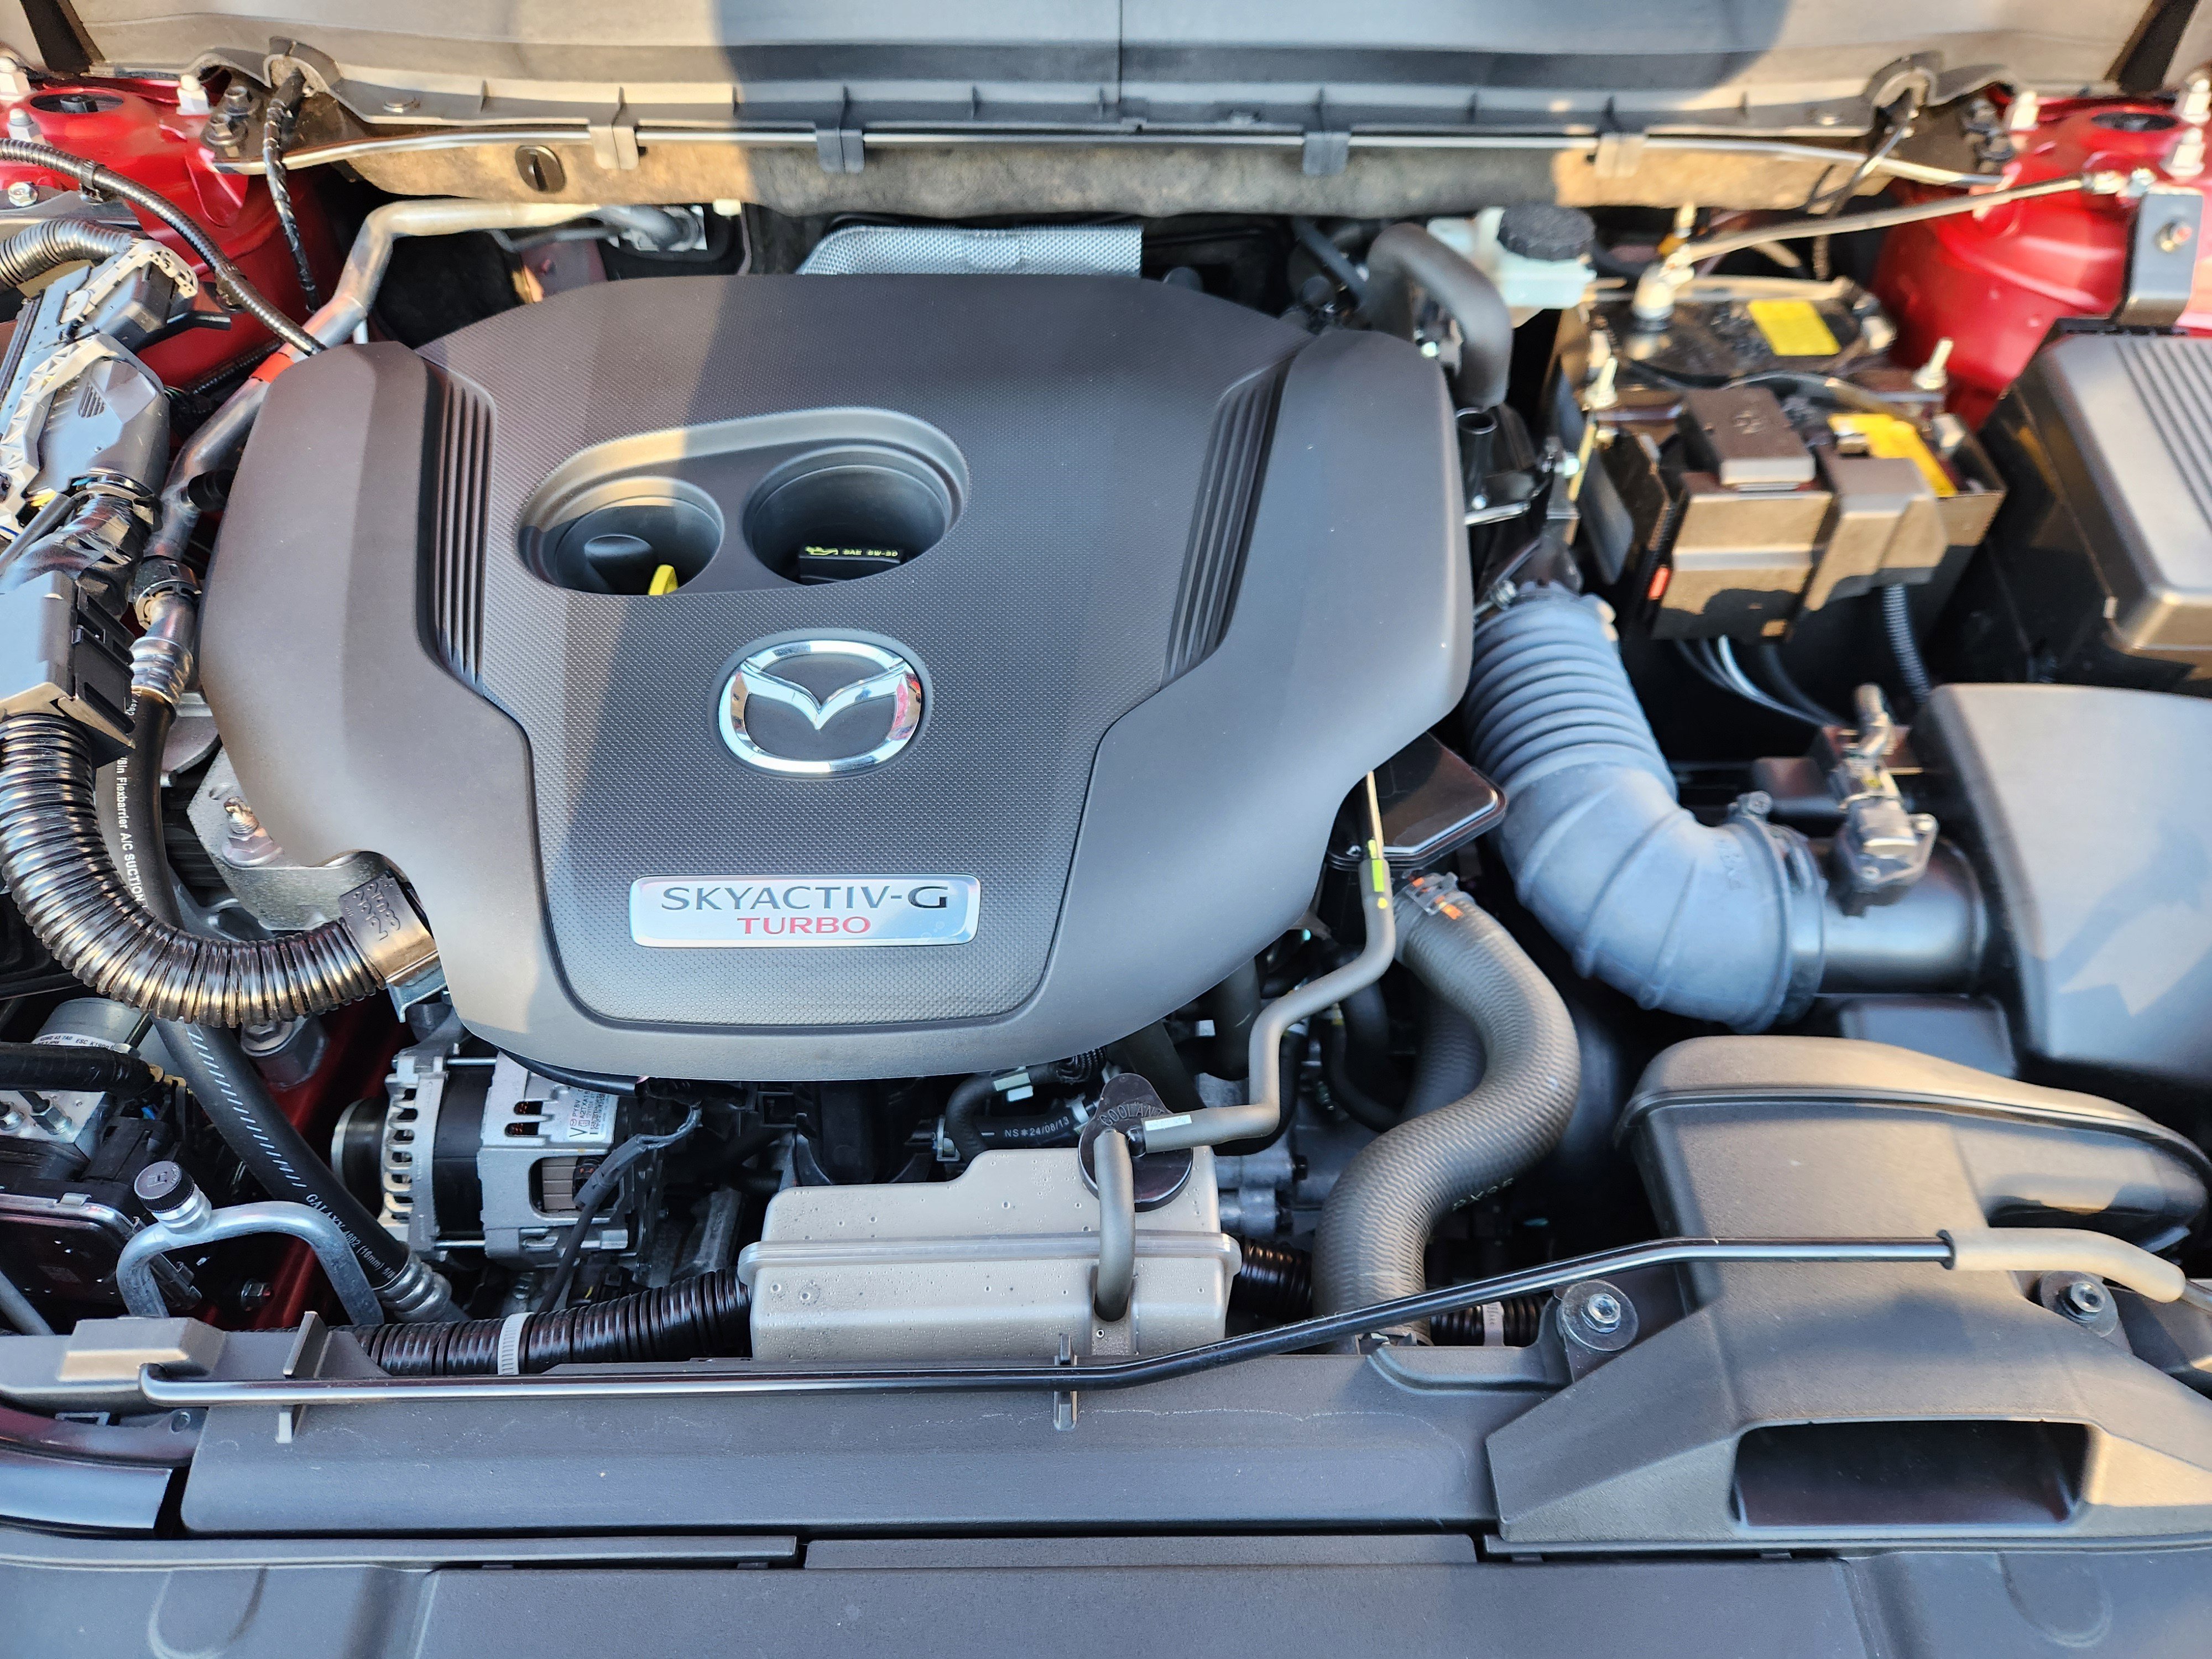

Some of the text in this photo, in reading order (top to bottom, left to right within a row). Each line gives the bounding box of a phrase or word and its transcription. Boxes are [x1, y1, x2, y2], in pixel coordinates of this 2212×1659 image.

[116, 776, 129, 829] Flexbarrier
[120, 833, 133, 851] A/C
[124, 853, 145, 902] SUCTION
[661, 885, 948, 910] SKYACTIV-G
[737, 916, 872, 935] TURBO
